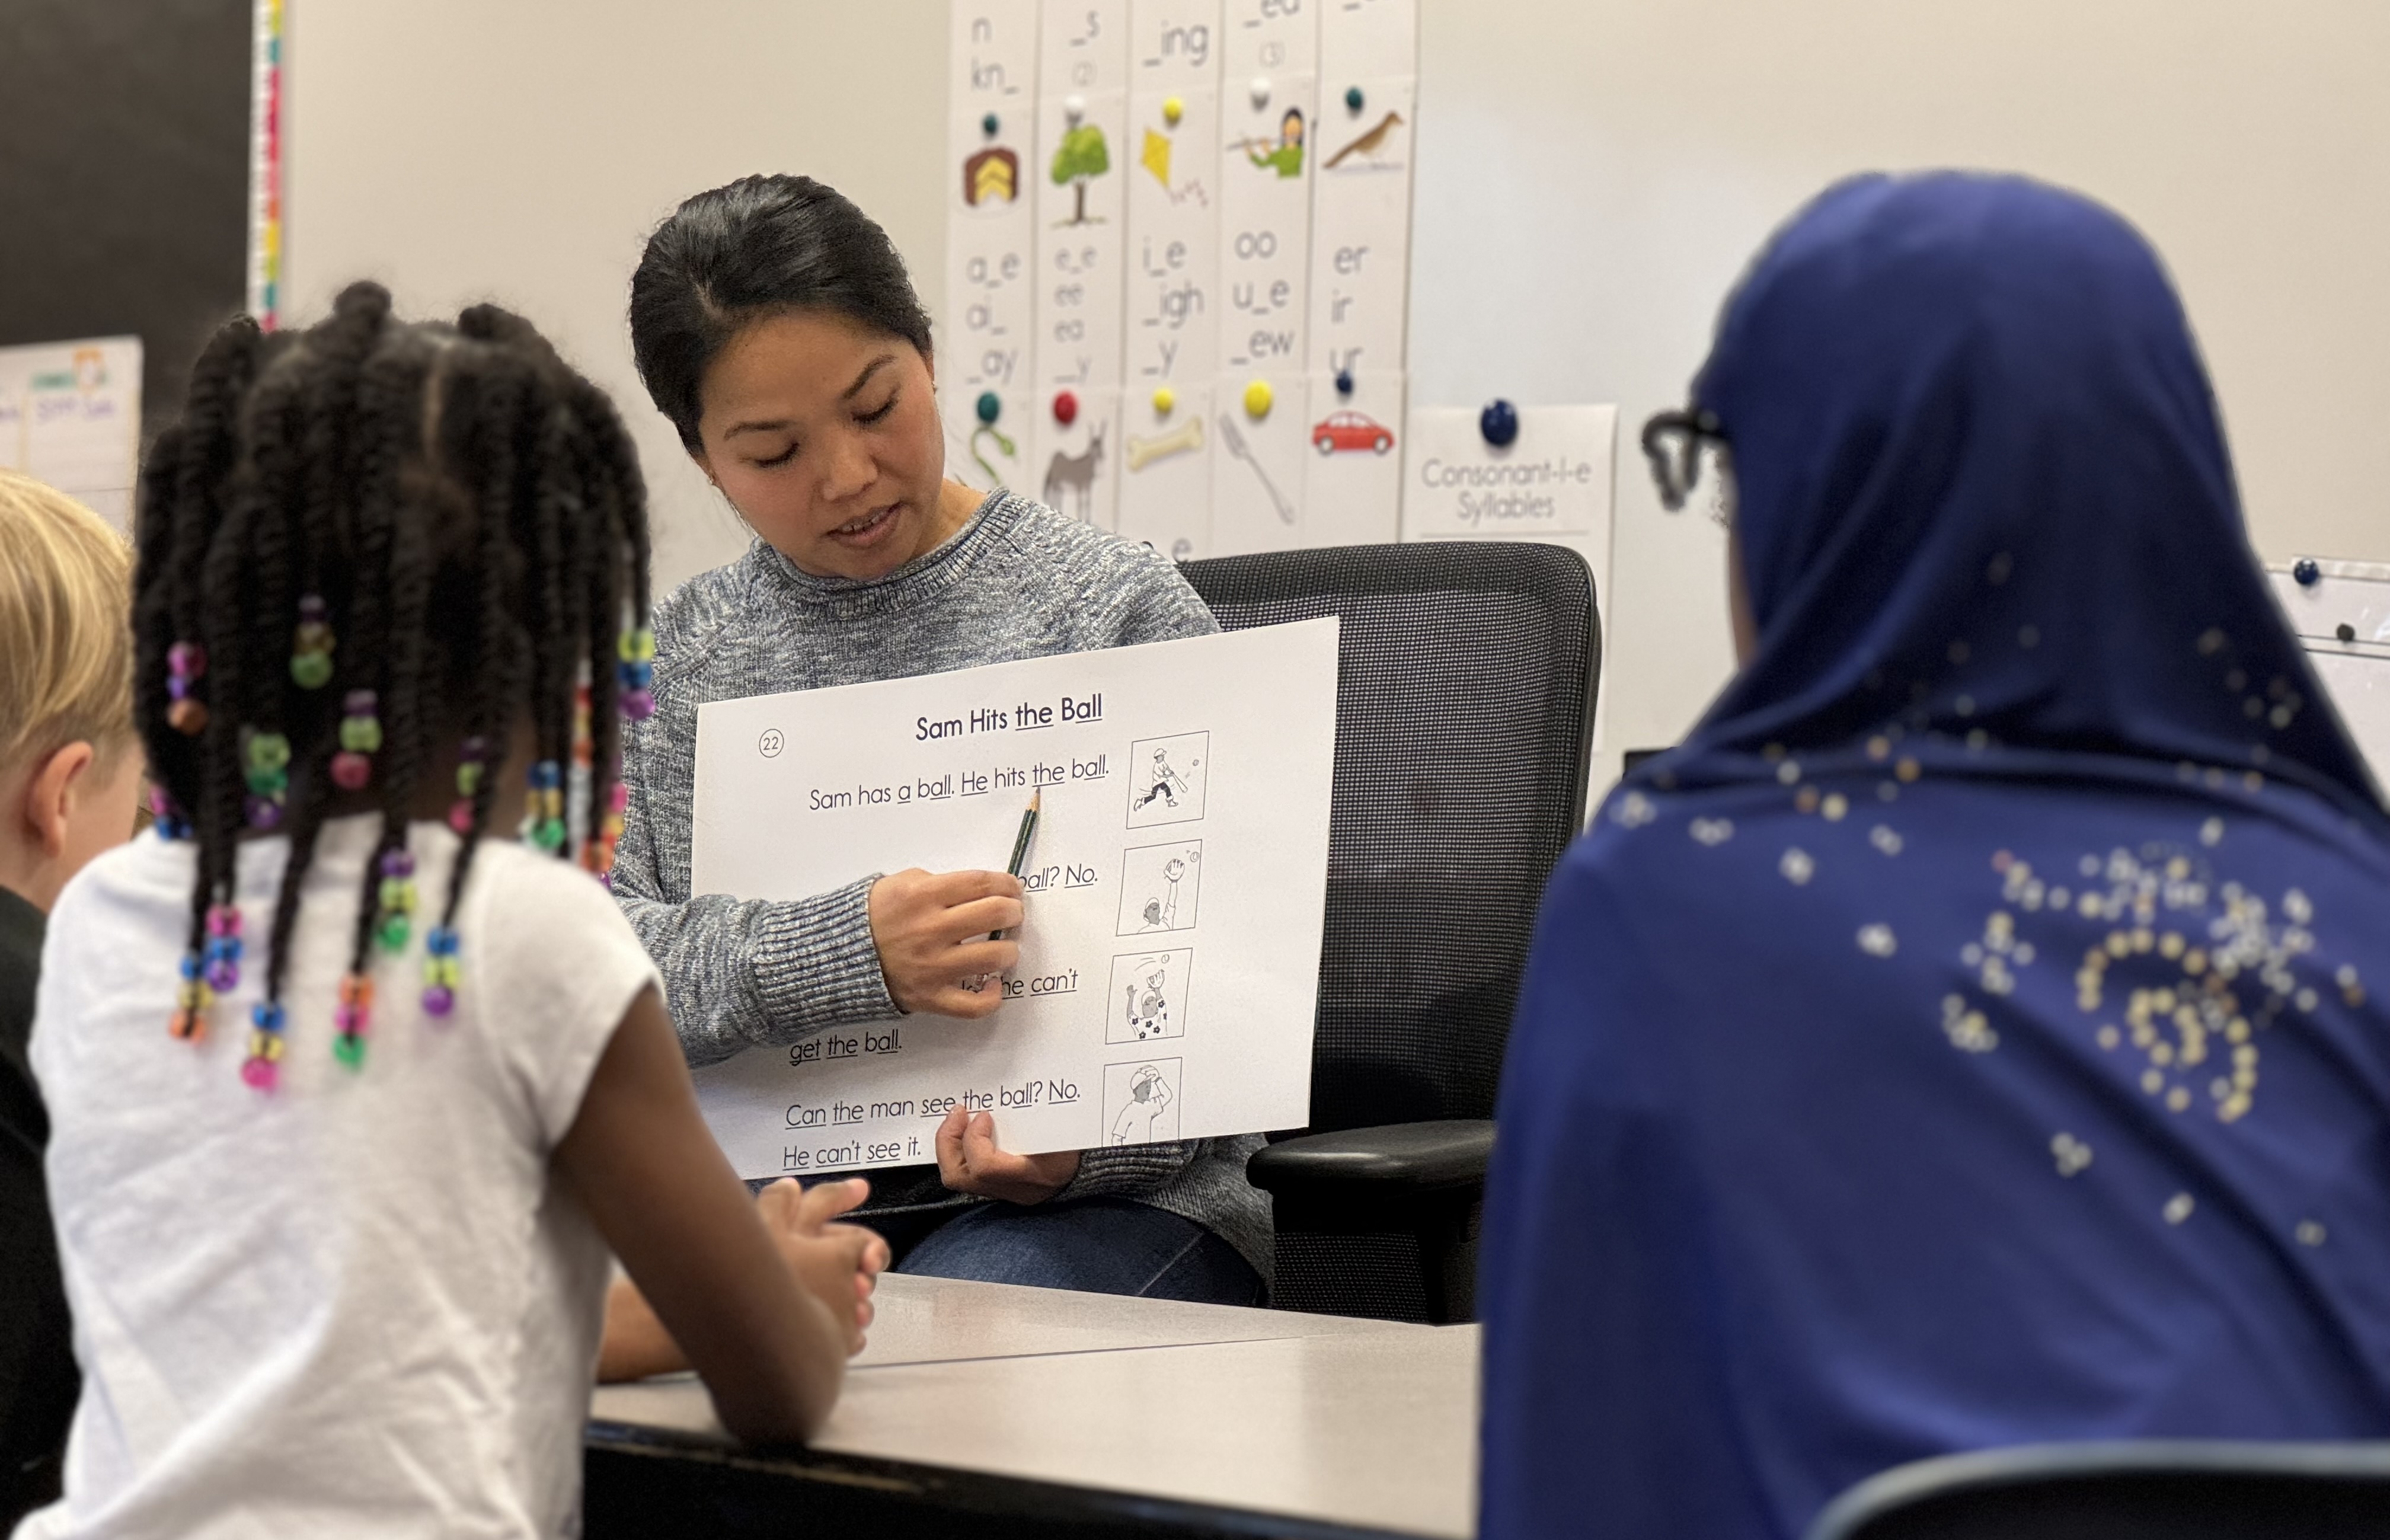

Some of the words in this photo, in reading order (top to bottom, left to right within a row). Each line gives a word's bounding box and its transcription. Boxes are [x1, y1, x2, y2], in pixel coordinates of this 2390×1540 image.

[972, 17, 992, 43] n
[1234, 231, 1277, 260] oo
[1334, 245, 1369, 275] er
[1331, 289, 1353, 324] ir
[1457, 491, 1555, 527] Syllables
[916, 717, 962, 740] Sam
[970, 709, 1008, 733] Hits
[1015, 702, 1053, 727] the
[1062, 694, 1102, 720] Ball
[810, 789, 851, 810] Sam
[858, 785, 891, 805] has
[898, 787, 910, 801] a
[918, 774, 954, 798] ball.
[961, 772, 988, 792] He
[995, 767, 1025, 788] hits
[1033, 762, 1065, 784] the
[1072, 755, 1109, 778] ball.
[1065, 864, 1098, 884] No.
[1031, 969, 1078, 993] can't
[790, 1040, 820, 1066] get
[827, 1034, 858, 1056] the
[865, 1029, 902, 1053] ball.
[786, 1104, 826, 1126] Can
[832, 1100, 864, 1122] the
[871, 1101, 913, 1118] man
[921, 1097, 956, 1114] see
[963, 1089, 993, 1110] the
[1001, 1081, 1042, 1107] ball?
[1049, 1078, 1081, 1100] No.
[784, 1146, 809, 1168] He
[816, 1139, 861, 1164] can't
[867, 1140, 900, 1158] see
[907, 1137, 921, 1156] it.
